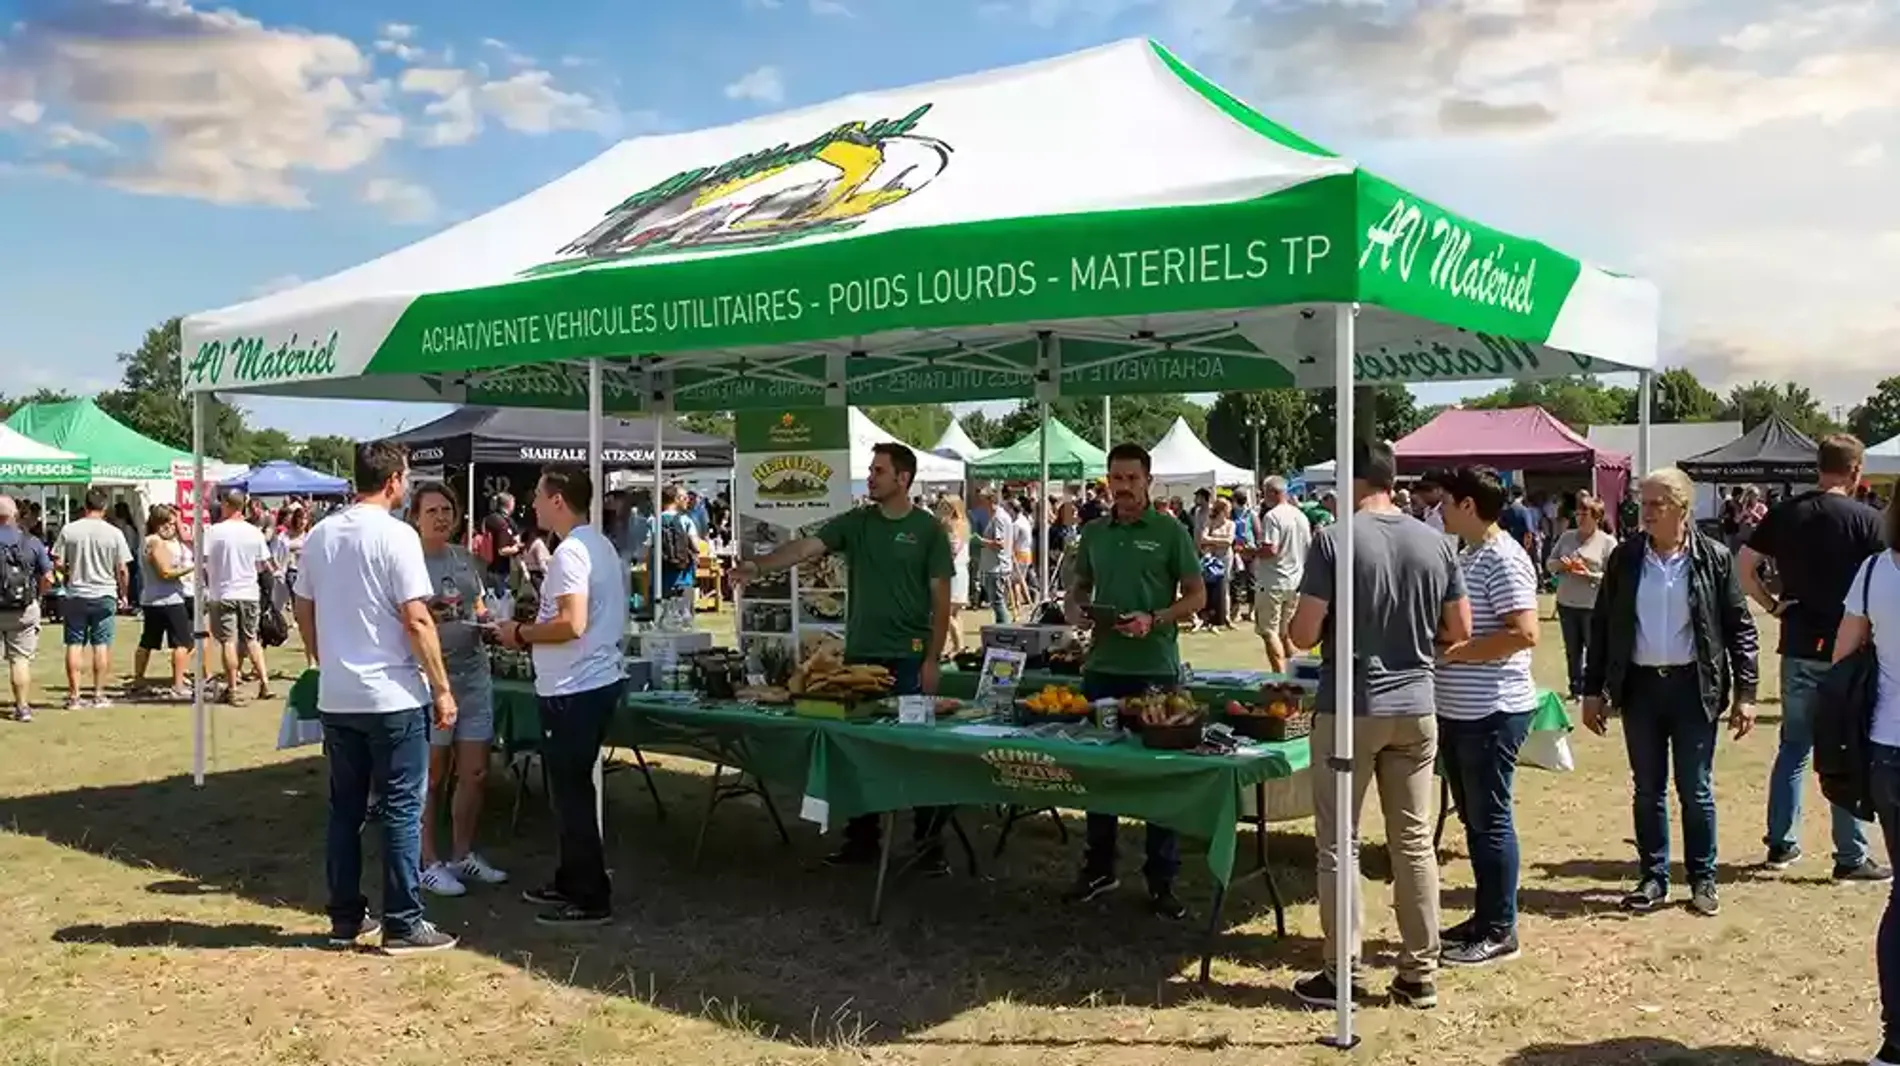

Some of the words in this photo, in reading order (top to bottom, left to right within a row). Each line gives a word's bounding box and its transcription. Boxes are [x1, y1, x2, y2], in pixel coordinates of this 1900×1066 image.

[421, 315, 540, 355] ACHAT/VENTE
[544, 302, 658, 342] VEHICULES
[662, 288, 803, 331] UTILITAIRES
[829, 274, 908, 315] POIDS
[918, 260, 1037, 305] LOURDS
[1070, 238, 1269, 292] MATERIELS
[1280, 234, 1331, 276] TP
[1359, 198, 1428, 283] AV
[1430, 217, 1537, 316] Matériel
[185, 339, 228, 384] AV
[229, 330, 339, 381] Matériel
